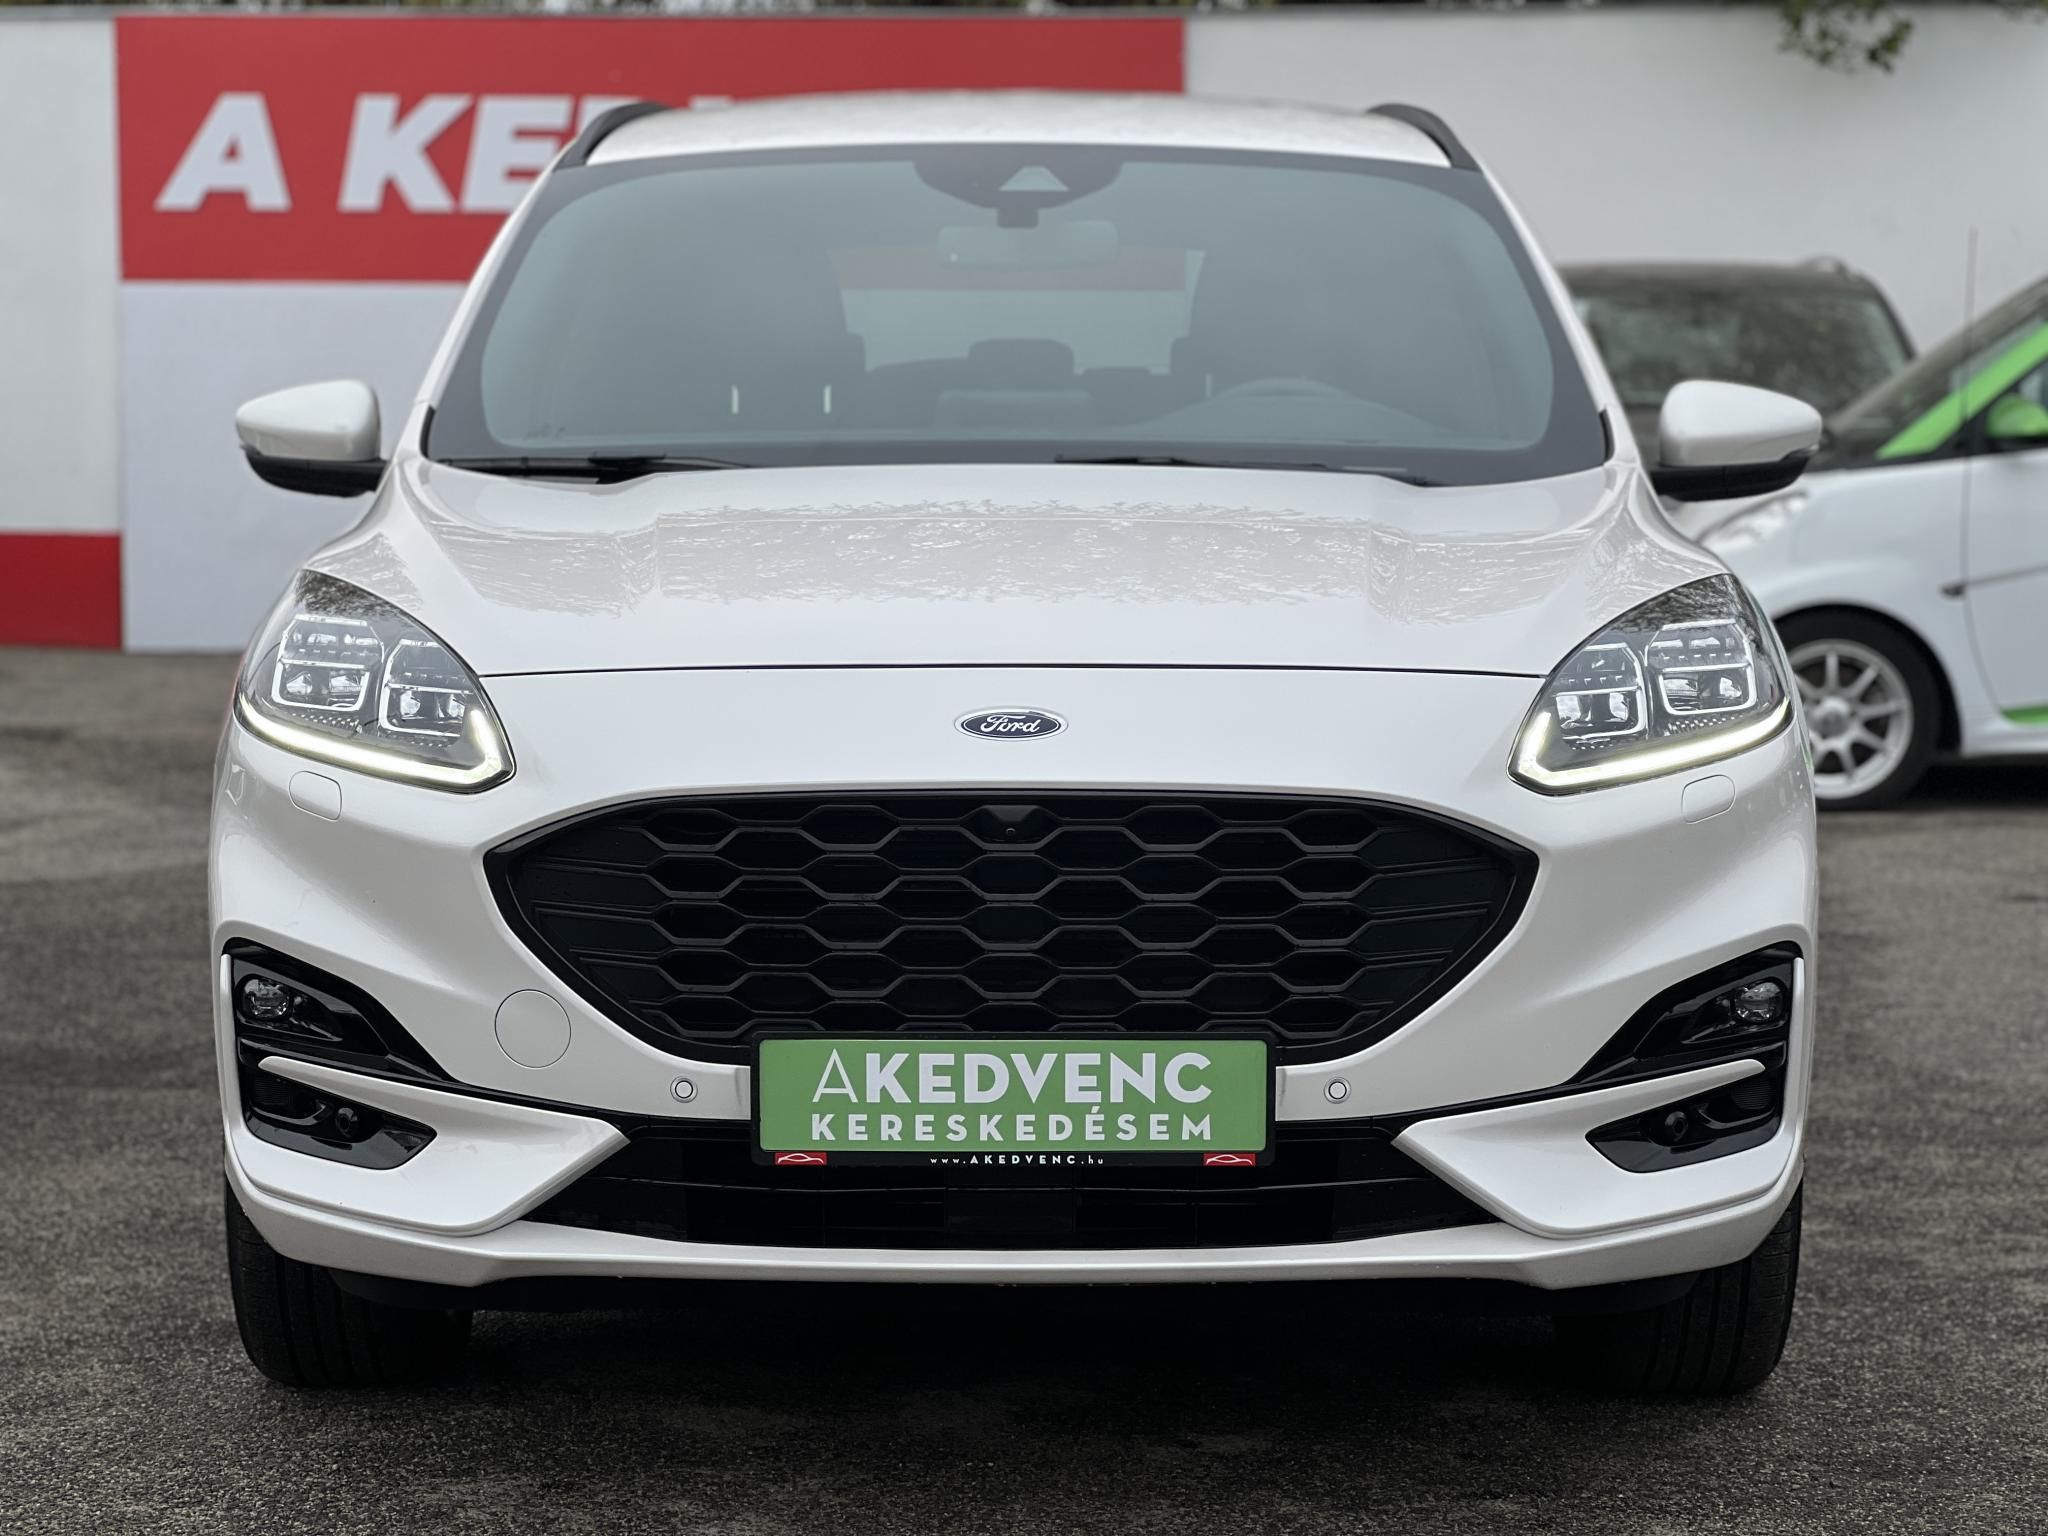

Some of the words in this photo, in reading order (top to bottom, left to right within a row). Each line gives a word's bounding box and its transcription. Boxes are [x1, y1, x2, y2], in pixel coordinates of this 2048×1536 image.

[154, 91, 292, 213] A
[980, 714, 1041, 732] Ford
[812, 1048, 1212, 1104] AKEDVENC
[811, 1106, 1211, 1141] KERESKEDÉSEM
[930, 1154, 1104, 1165] www.AKEDVENC.hu
